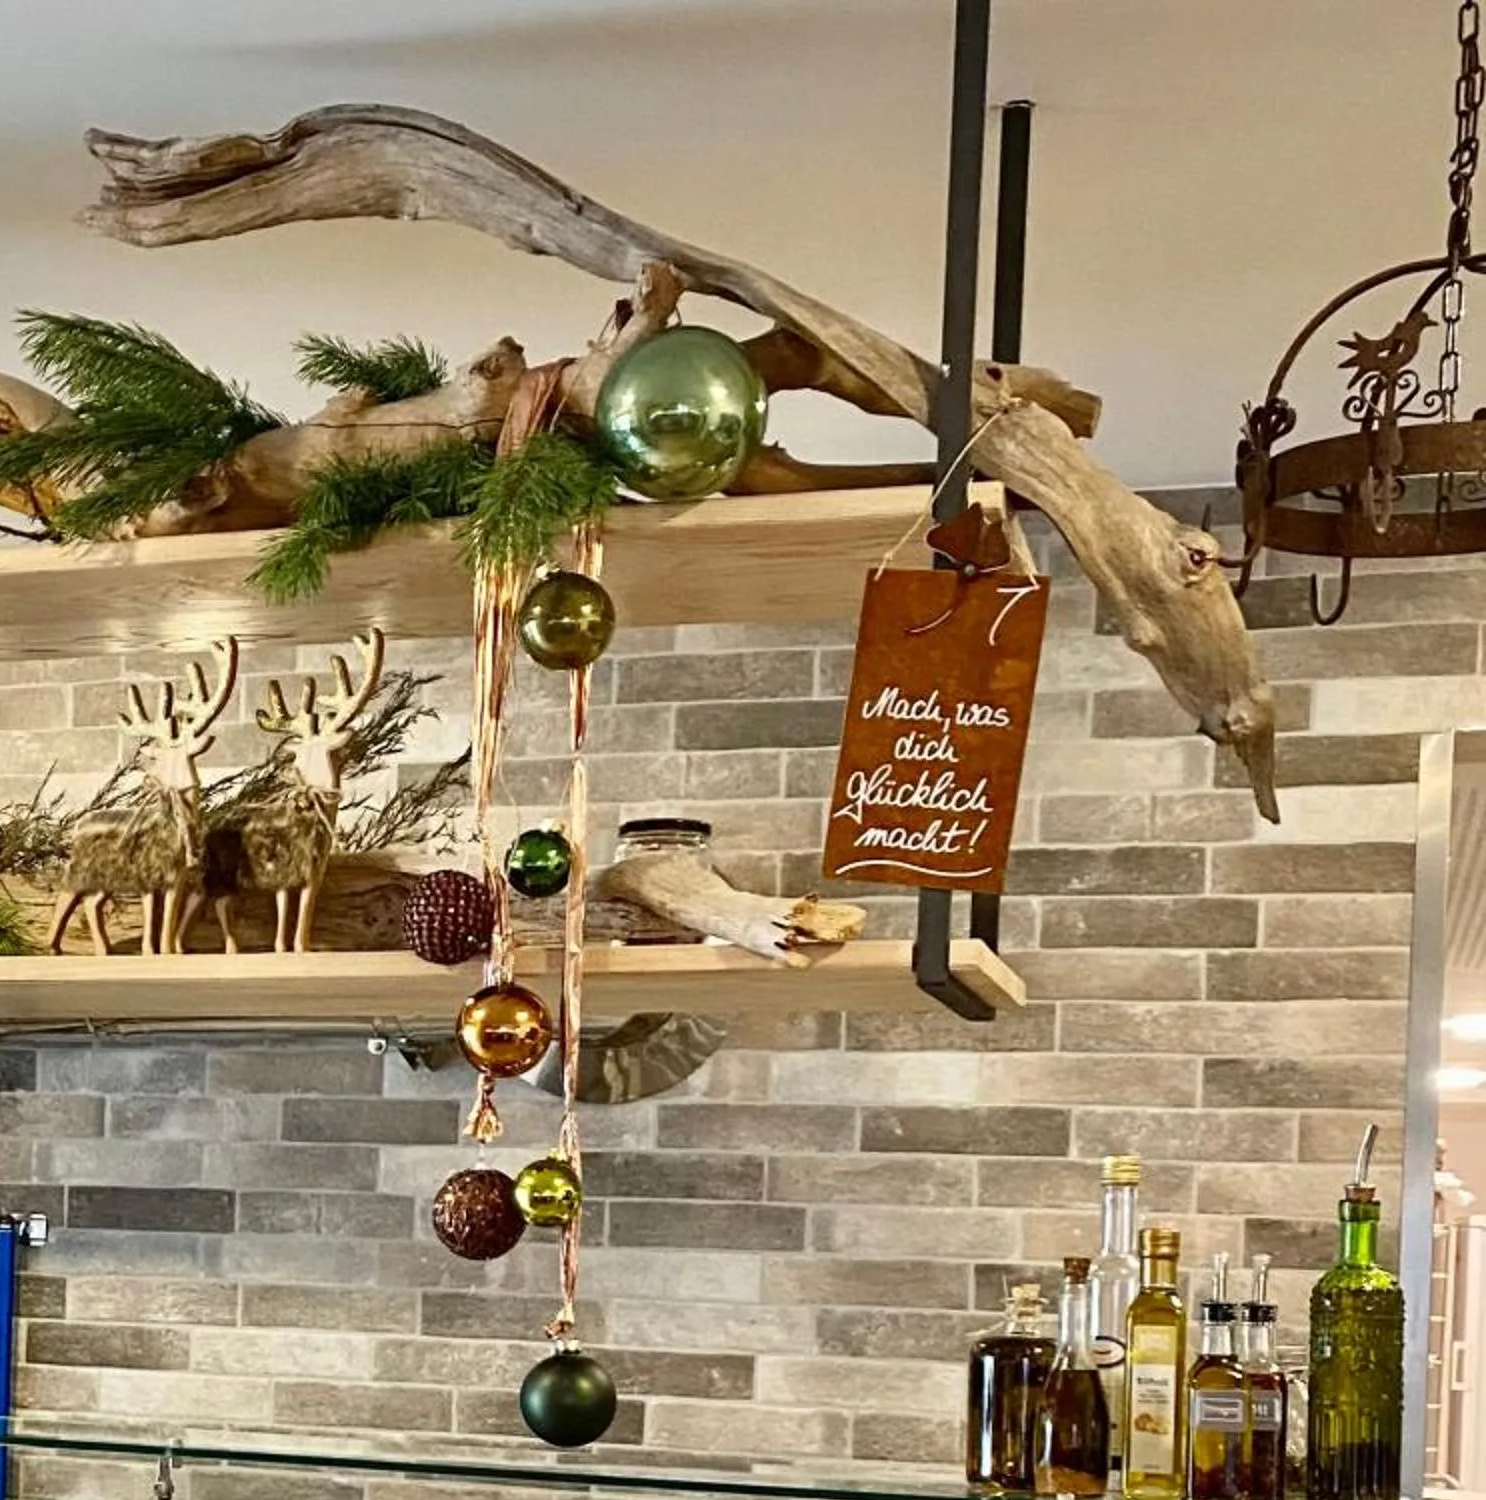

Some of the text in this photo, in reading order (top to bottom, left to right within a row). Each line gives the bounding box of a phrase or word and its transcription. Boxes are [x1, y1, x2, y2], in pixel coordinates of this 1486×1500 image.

[955, 702, 1010, 727] was
[894, 731, 959, 763] dich
[854, 819, 989, 855] macht!
